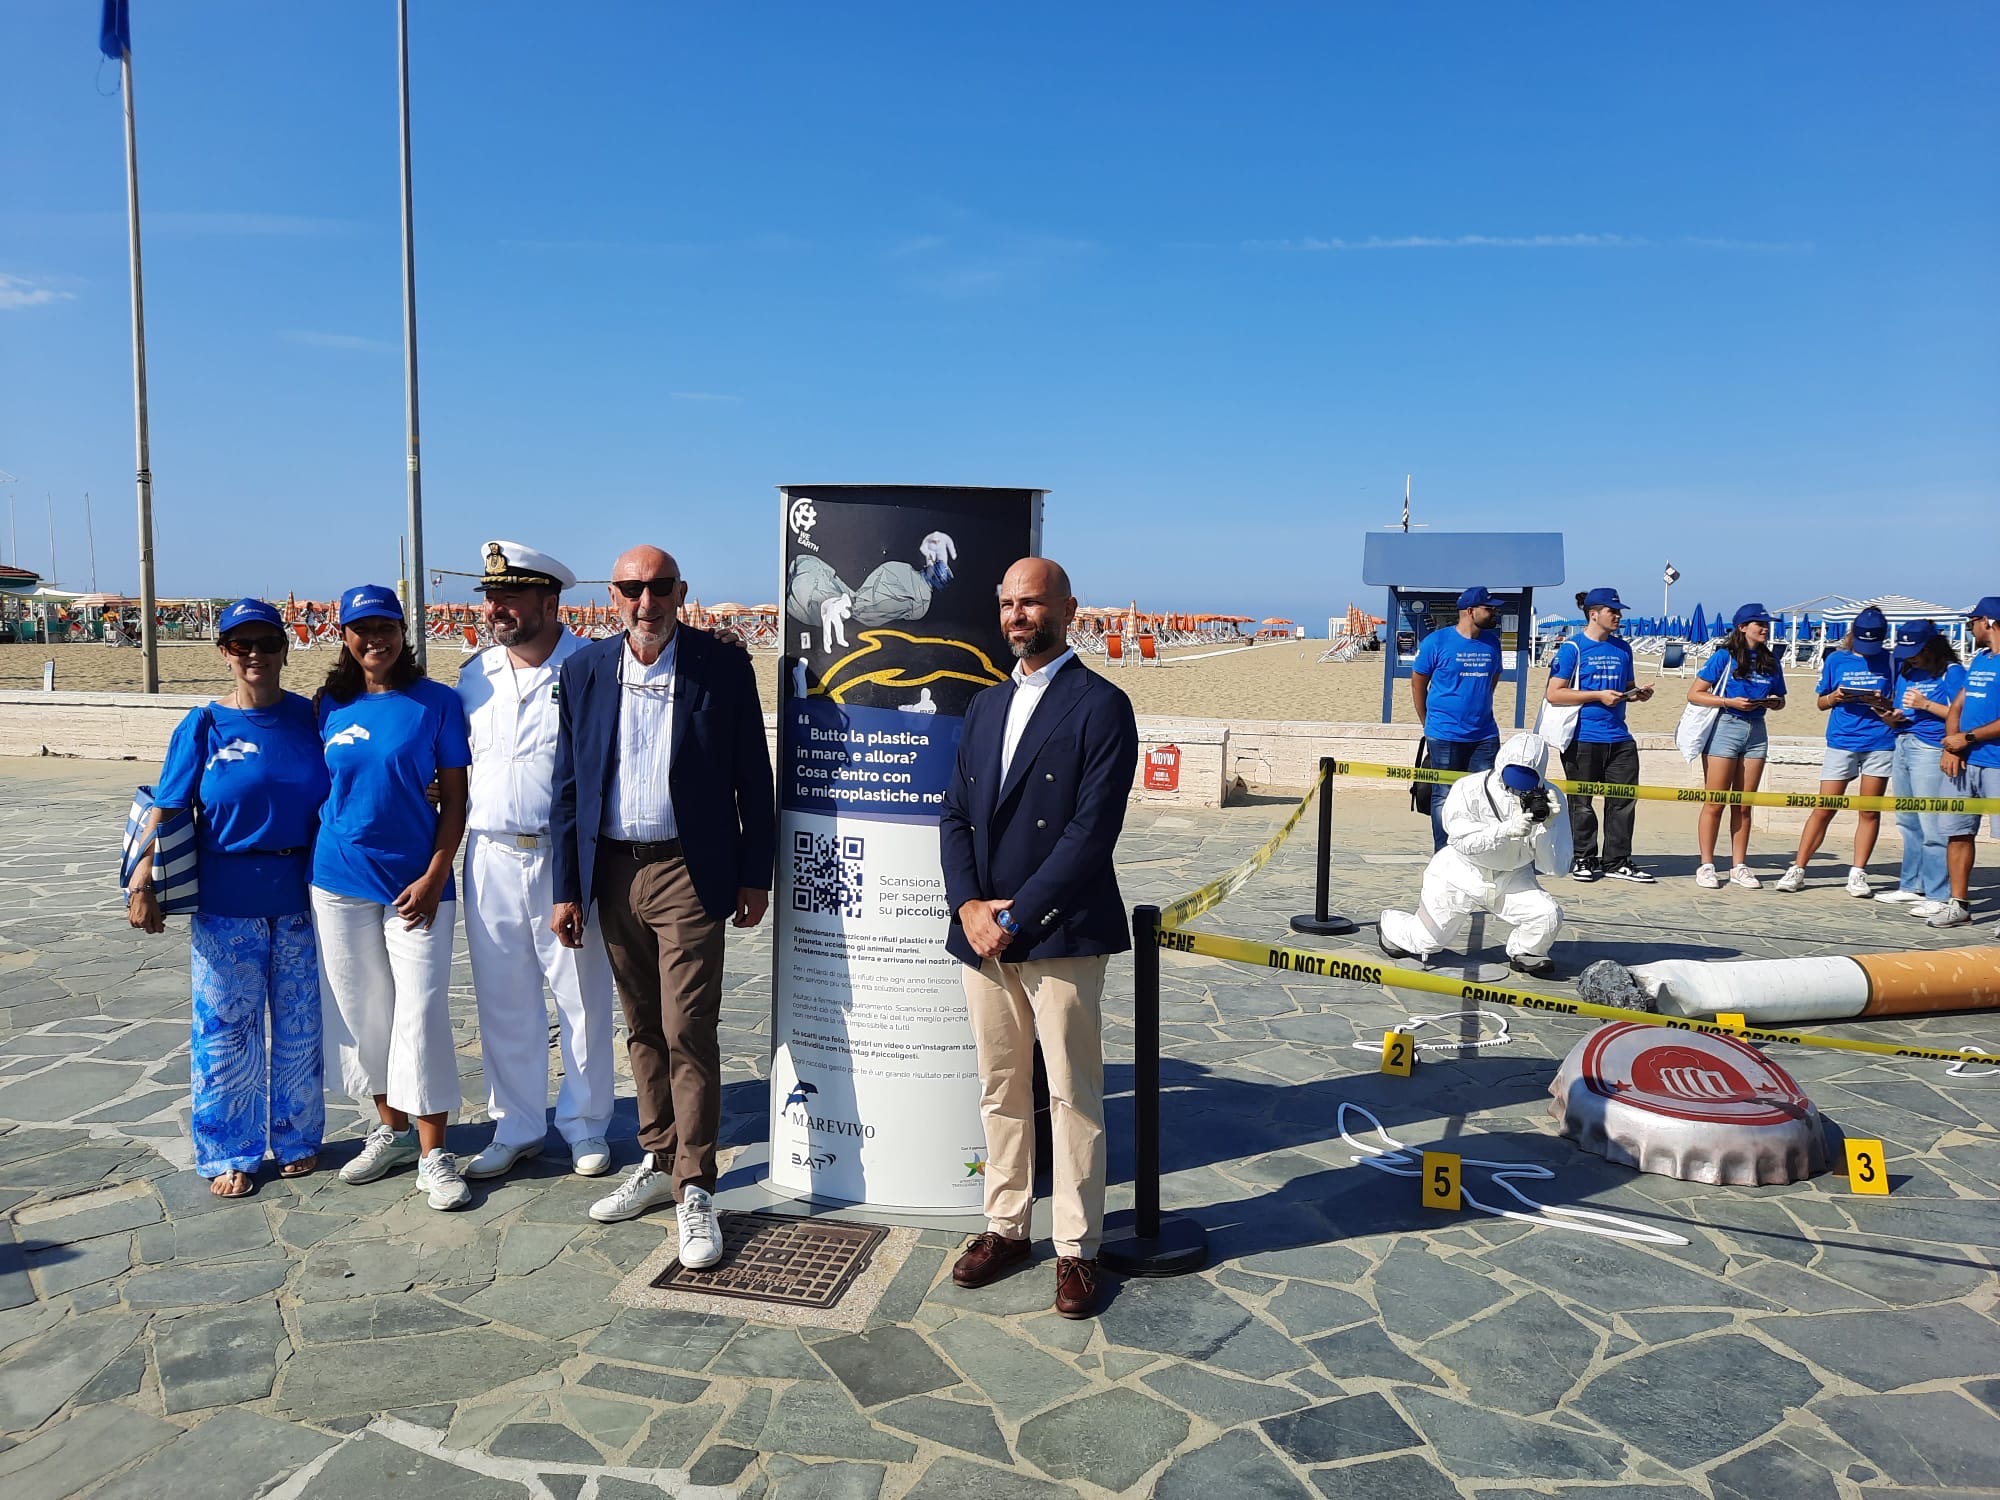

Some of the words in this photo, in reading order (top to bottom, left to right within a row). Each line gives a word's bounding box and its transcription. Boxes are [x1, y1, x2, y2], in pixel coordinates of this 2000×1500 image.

[797, 536, 820, 552] EARTH
[810, 728, 848, 742] Butto
[851, 730, 864, 743] la
[868, 731, 929, 748] plastica
[797, 746, 808, 758] in
[812, 749, 849, 763] mare,
[852, 751, 862, 762] e
[865, 750, 918, 764] allora?
[1151, 752, 1175, 766] WDYW
[796, 765, 828, 778] Cosa
[832, 767, 880, 782] c'entro
[883, 772, 911, 784] con
[796, 782, 808, 796] le
[812, 785, 919, 802] microplastiche
[880, 876, 940, 888] Scansiona
[880, 892, 899, 902] per
[879, 906, 892, 914] su
[837, 932, 870, 942] mozziconi
[900, 936, 927, 946] plastici
[1152, 928, 1195, 952] SCENE
[857, 944, 866, 952] gli
[830, 952, 850, 960] acqua
[858, 954, 875, 962] terra
[883, 956, 913, 964] arrivano
[1268, 949, 1290, 970] DO
[1294, 954, 1325, 975] NOT
[1330, 960, 1382, 984] CROSS
[890, 977, 906, 985] ogni
[874, 985, 904, 993] soluzioni
[1462, 986, 1517, 1004] CRIME
[896, 1004, 931, 1013] Scansiona
[848, 1040, 871, 1049] registri
[884, 1042, 904, 1050] video
[871, 1050, 920, 1060] #piccoligesti.
[1390, 1043, 1404, 1066] 2
[943, 1072, 955, 1080] per
[792, 1112, 875, 1138] MAREVIVO
[792, 1153, 826, 1170] BAT
[1857, 1152, 1875, 1182] 3
[1434, 1166, 1450, 1197] 5
